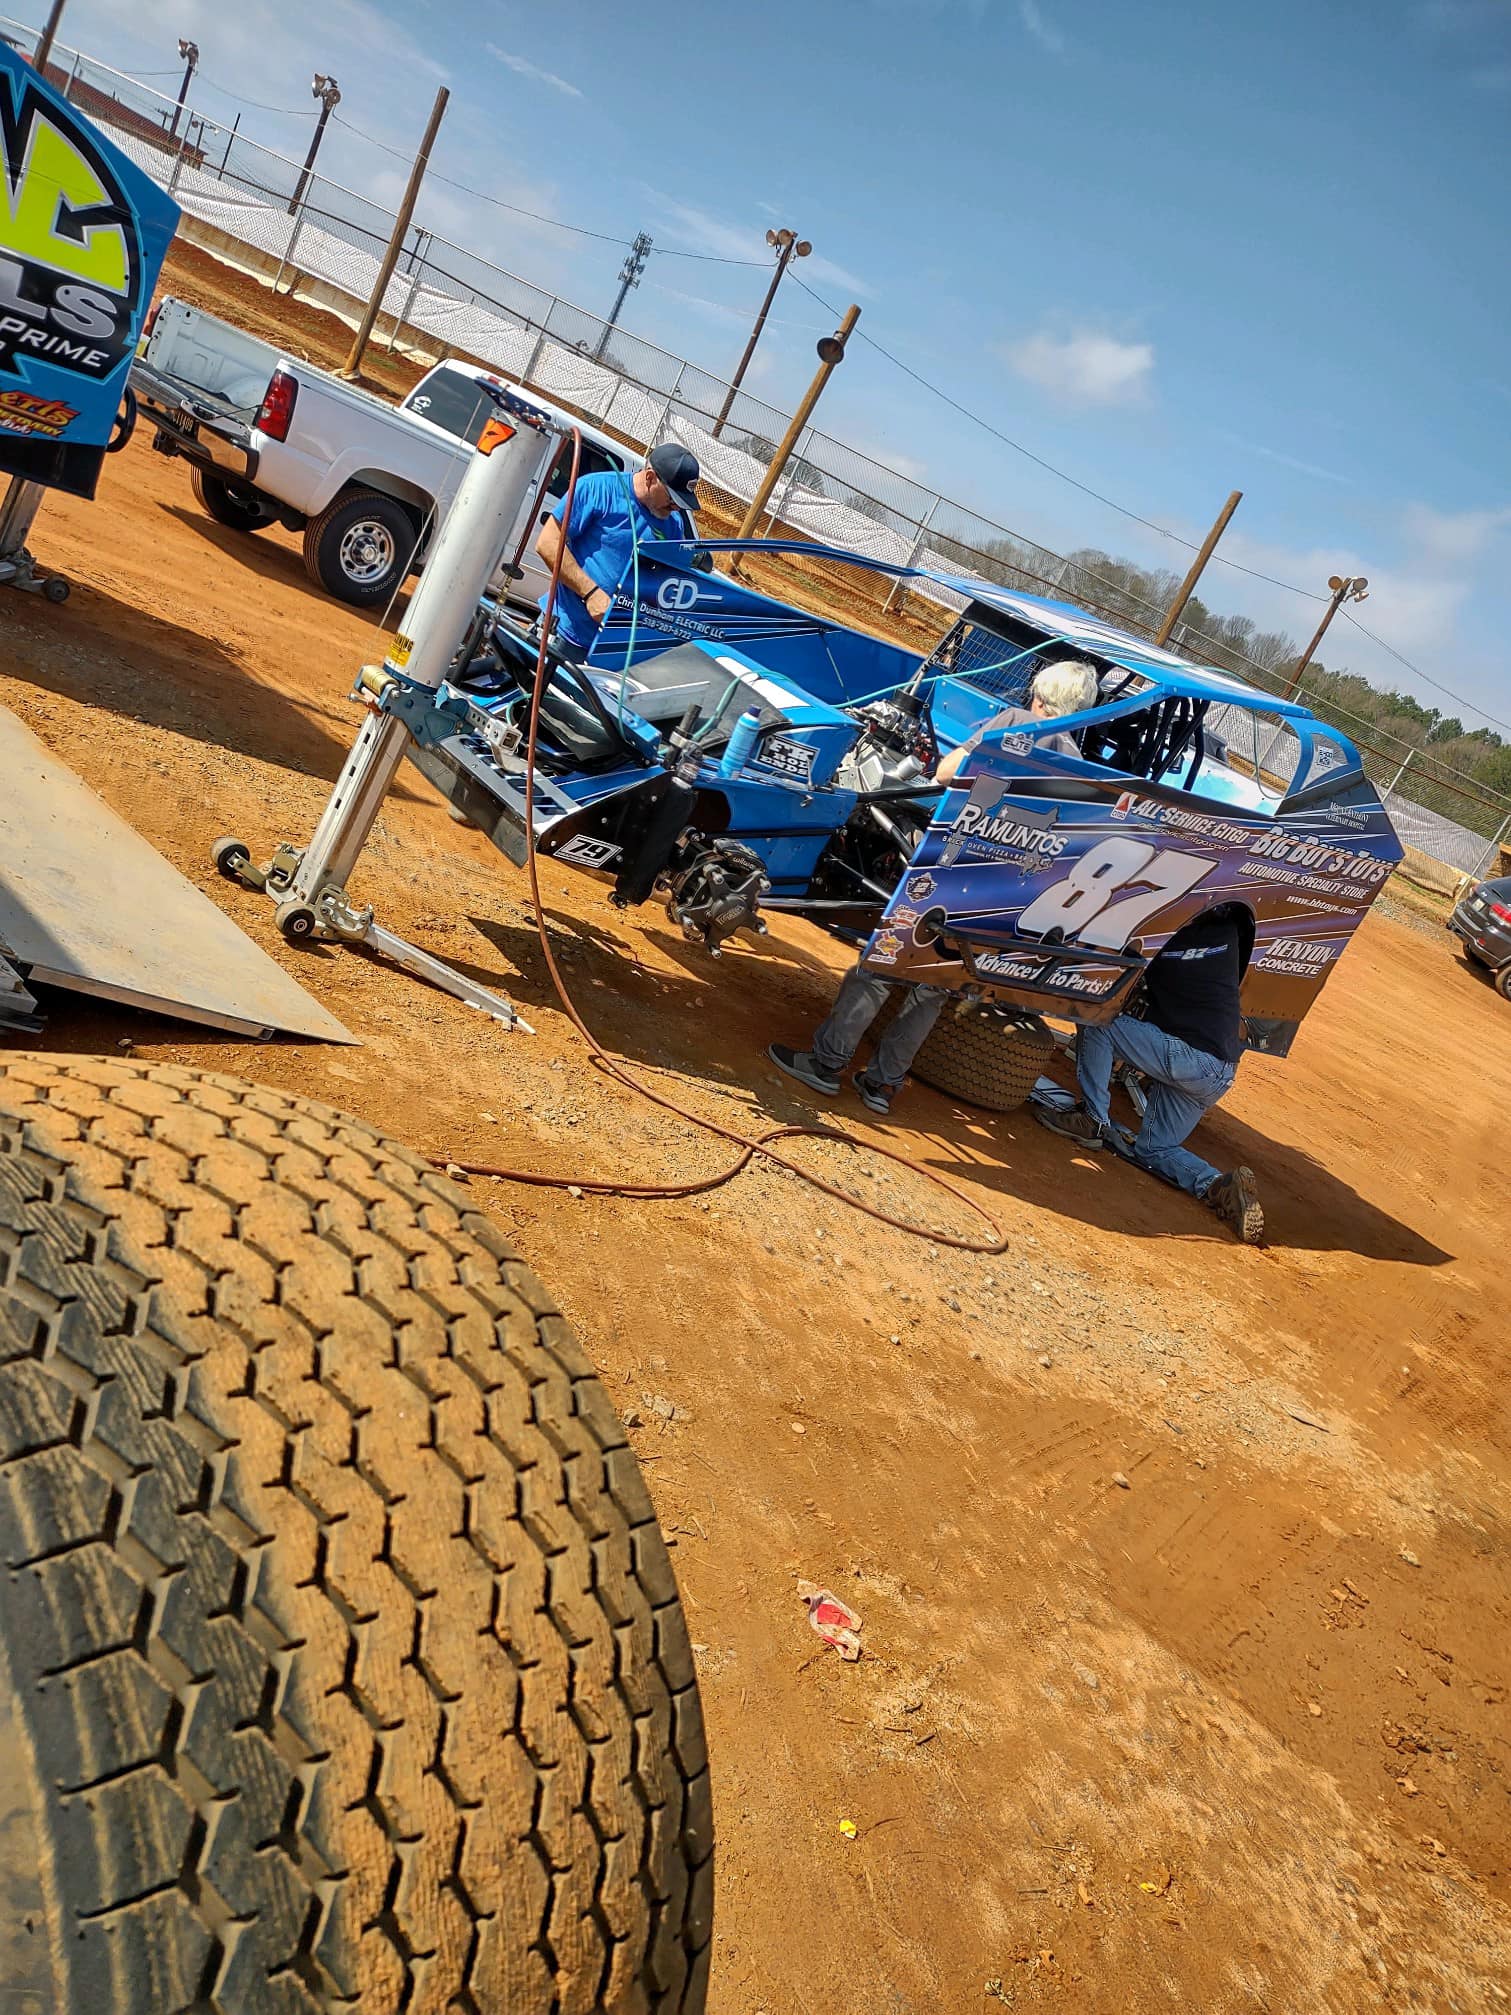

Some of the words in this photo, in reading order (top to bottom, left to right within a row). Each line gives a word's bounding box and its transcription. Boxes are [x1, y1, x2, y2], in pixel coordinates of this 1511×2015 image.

[0, 316, 110, 367] PRIME
[617, 595, 638, 609] Chri
[640, 603, 674, 622] Dunham
[676, 616, 710, 634] ELECTRIC
[710, 627, 724, 639] LLC
[950, 803, 1069, 856] RAMUNTOS
[1211, 823, 1250, 844] CITGO
[1249, 826, 1299, 860] BIG
[568, 839, 611, 859] 79
[967, 842, 987, 852] OVEN
[988, 847, 1010, 857] PIZZA
[1015, 835, 1221, 949] 87
[1240, 862, 1300, 886] AUTOMOTIVE
[1297, 874, 1343, 895] SPECIALTY
[1340, 885, 1370, 900] STORE
[1256, 957, 1322, 976] CONCRETE
[1265, 938, 1337, 963] KENYON
[975, 953, 1030, 979] Advance
[1066, 973, 1102, 993] Parts
